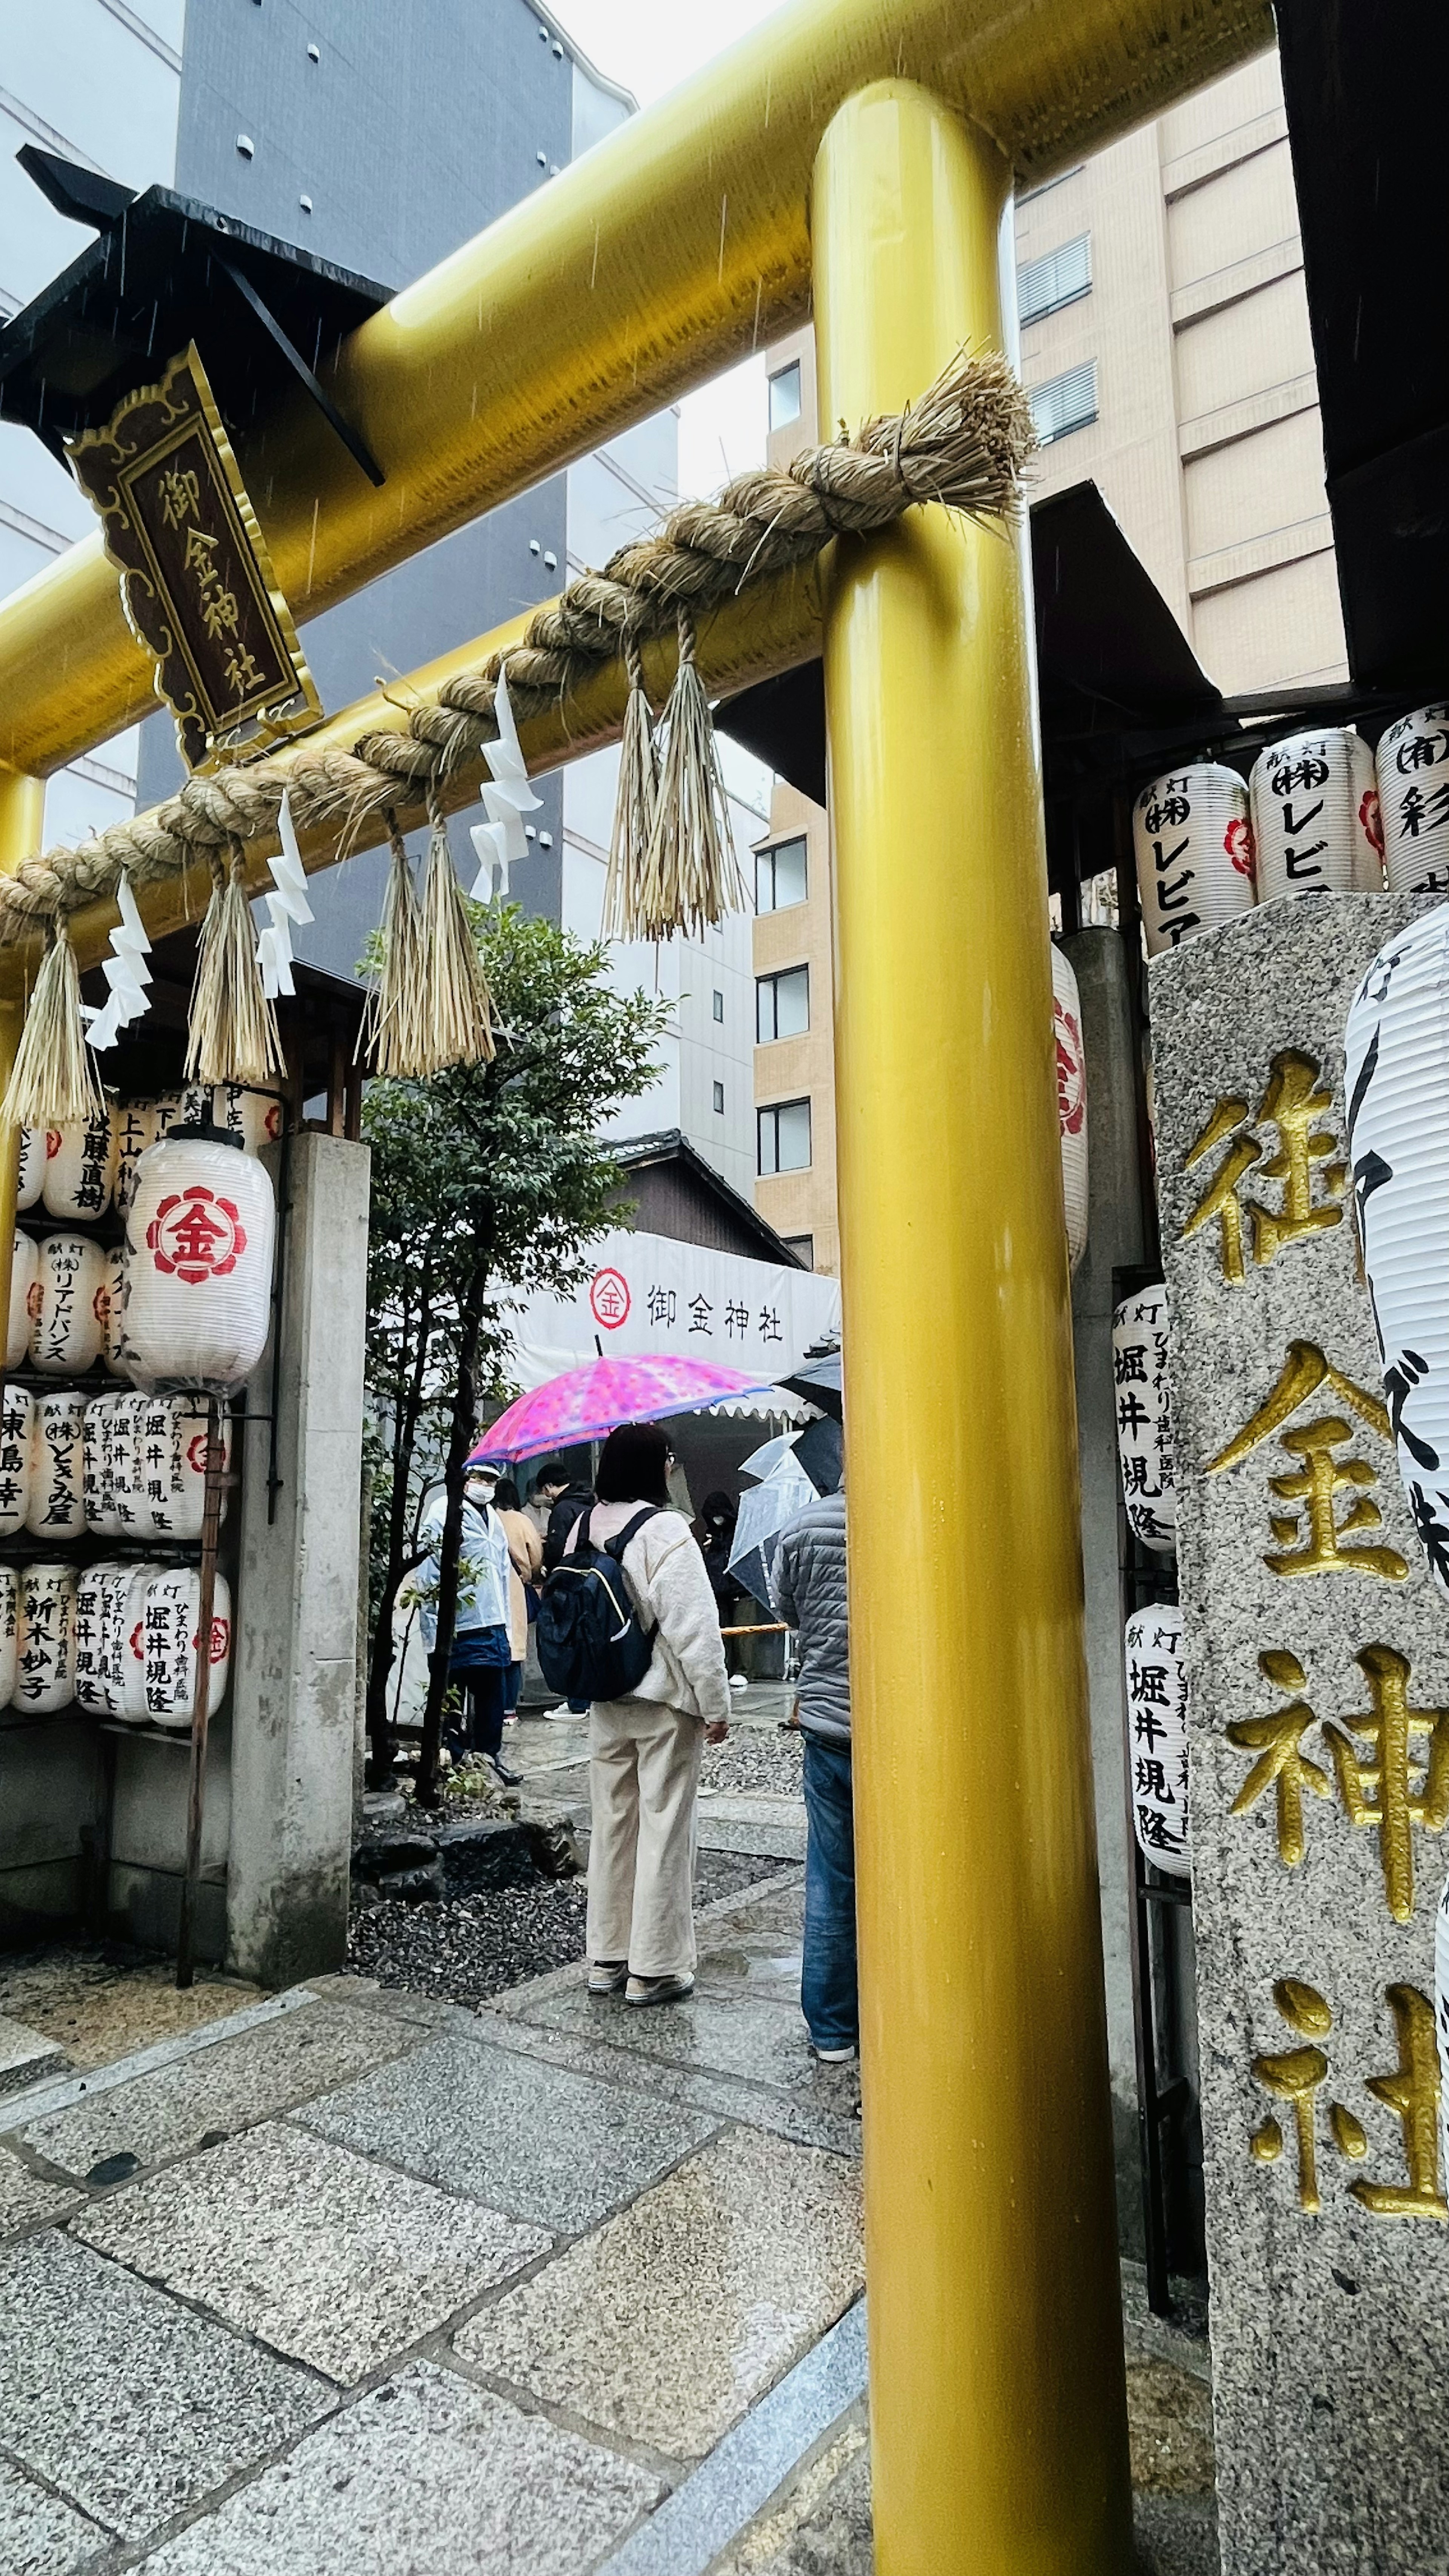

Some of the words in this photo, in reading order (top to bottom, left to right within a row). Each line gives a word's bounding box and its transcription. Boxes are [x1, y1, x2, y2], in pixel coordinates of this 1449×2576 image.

[158, 469, 266, 695] 御金神社
[1272, 758, 1332, 892] (株)レビ
[166, 1204, 228, 1262] 金
[647, 1285, 783, 1343] 御金神社
[0, 1408, 27, 1516] 東島幸一
[1115, 1344, 1175, 1540] 堀井規隆
[19, 1595, 57, 1699] 新木妙子
[146, 1606, 174, 1713] 堀井規隆
[174, 1603, 189, 1700] ひまわり歯科医院
[1130, 1659, 1186, 1855] 堀井規隆
